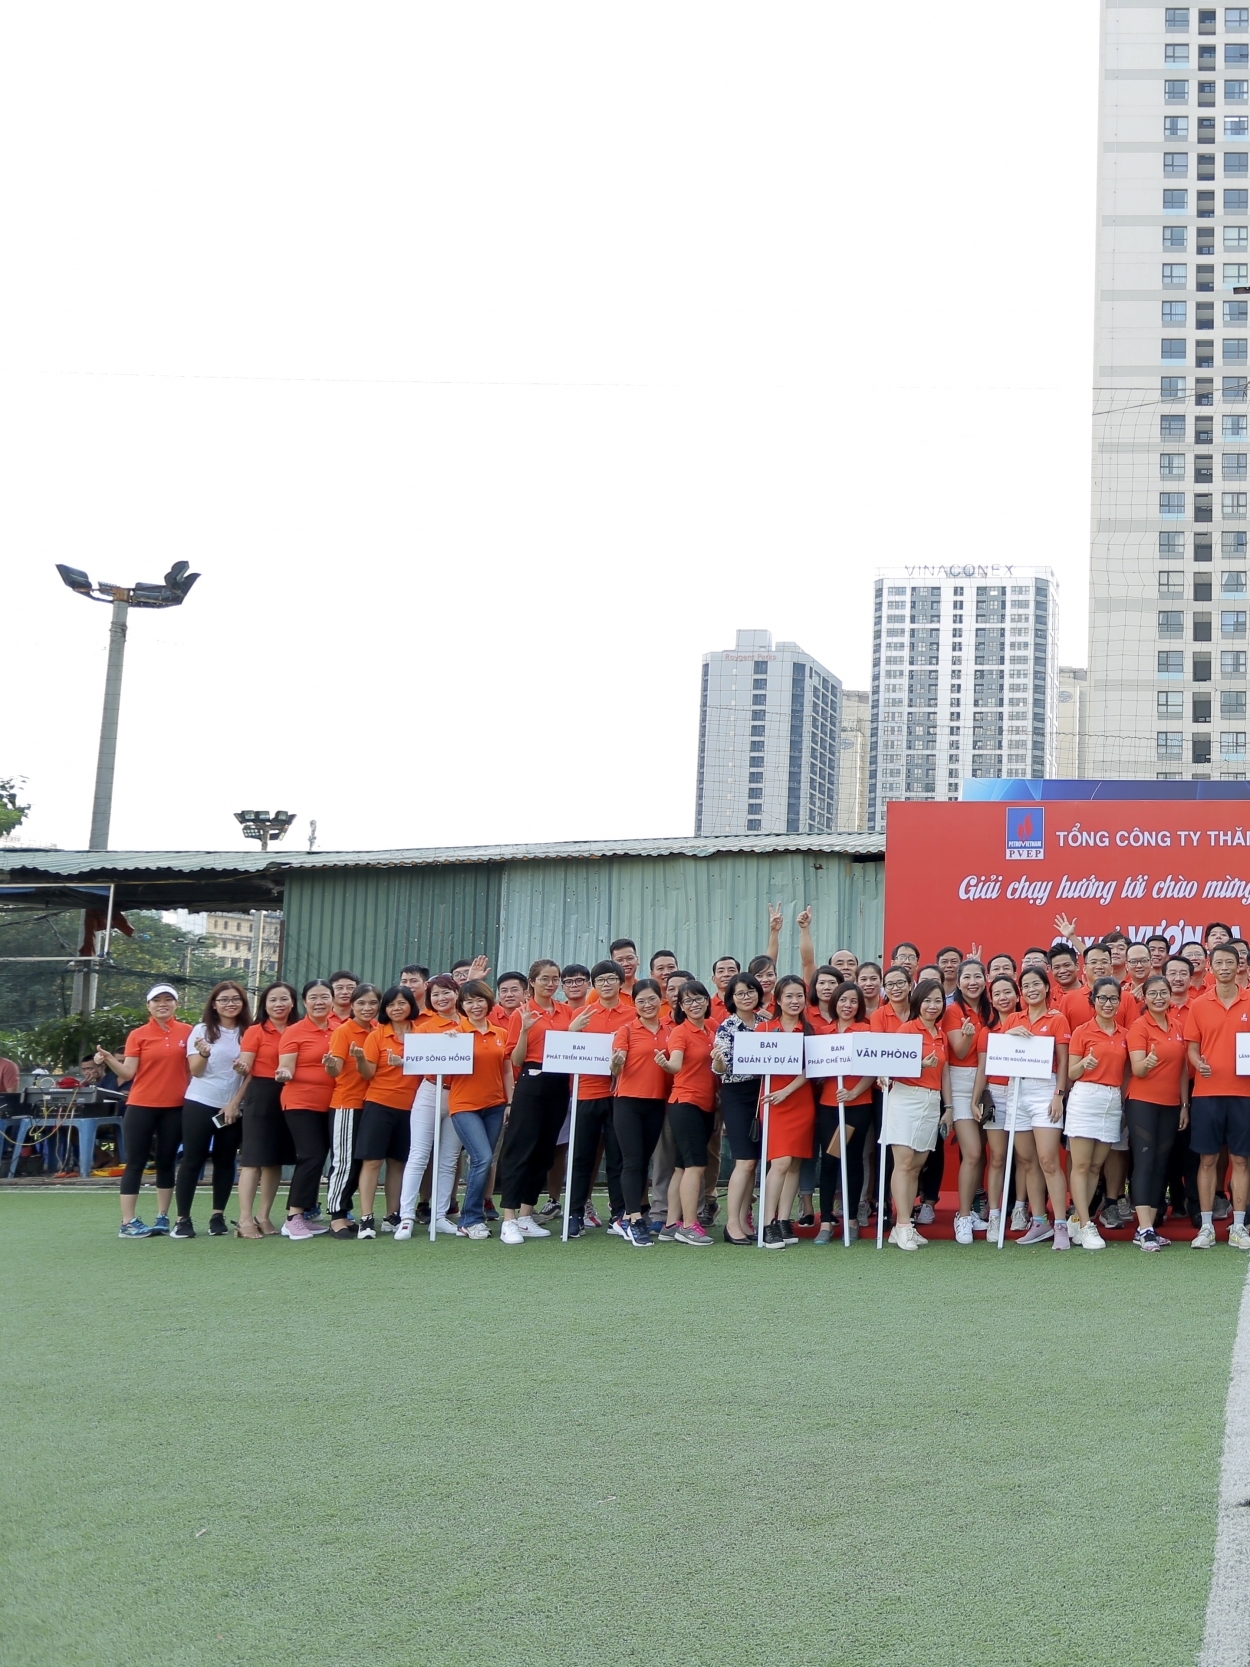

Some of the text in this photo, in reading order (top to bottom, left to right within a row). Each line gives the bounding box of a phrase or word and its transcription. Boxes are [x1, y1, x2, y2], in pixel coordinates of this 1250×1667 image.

[905, 563, 1014, 577] VINACONEX
[1055, 823, 1110, 847] TỔNG
[1115, 827, 1171, 847] CÔNG
[1177, 831, 1201, 847] TY
[1008, 850, 1042, 859] PVEP
[958, 874, 1003, 902] Giải
[1006, 874, 1053, 905] chạy
[1055, 874, 1118, 905] hướng
[1120, 875, 1148, 900] tới
[1152, 874, 1198, 900] chào
[760, 1041, 778, 1049] BAN
[425, 1053, 447, 1062] SÔNG
[449, 1052, 471, 1062] HỒNG
[562, 1053, 578, 1061] TRIỂN
[856, 1048, 918, 1059] VĂN PHÒNG
[737, 1054, 799, 1066] QUẢN LÝ DỰ ÁN
[807, 1057, 824, 1065] PHÁP
[825, 1055, 838, 1064] CHẾ
